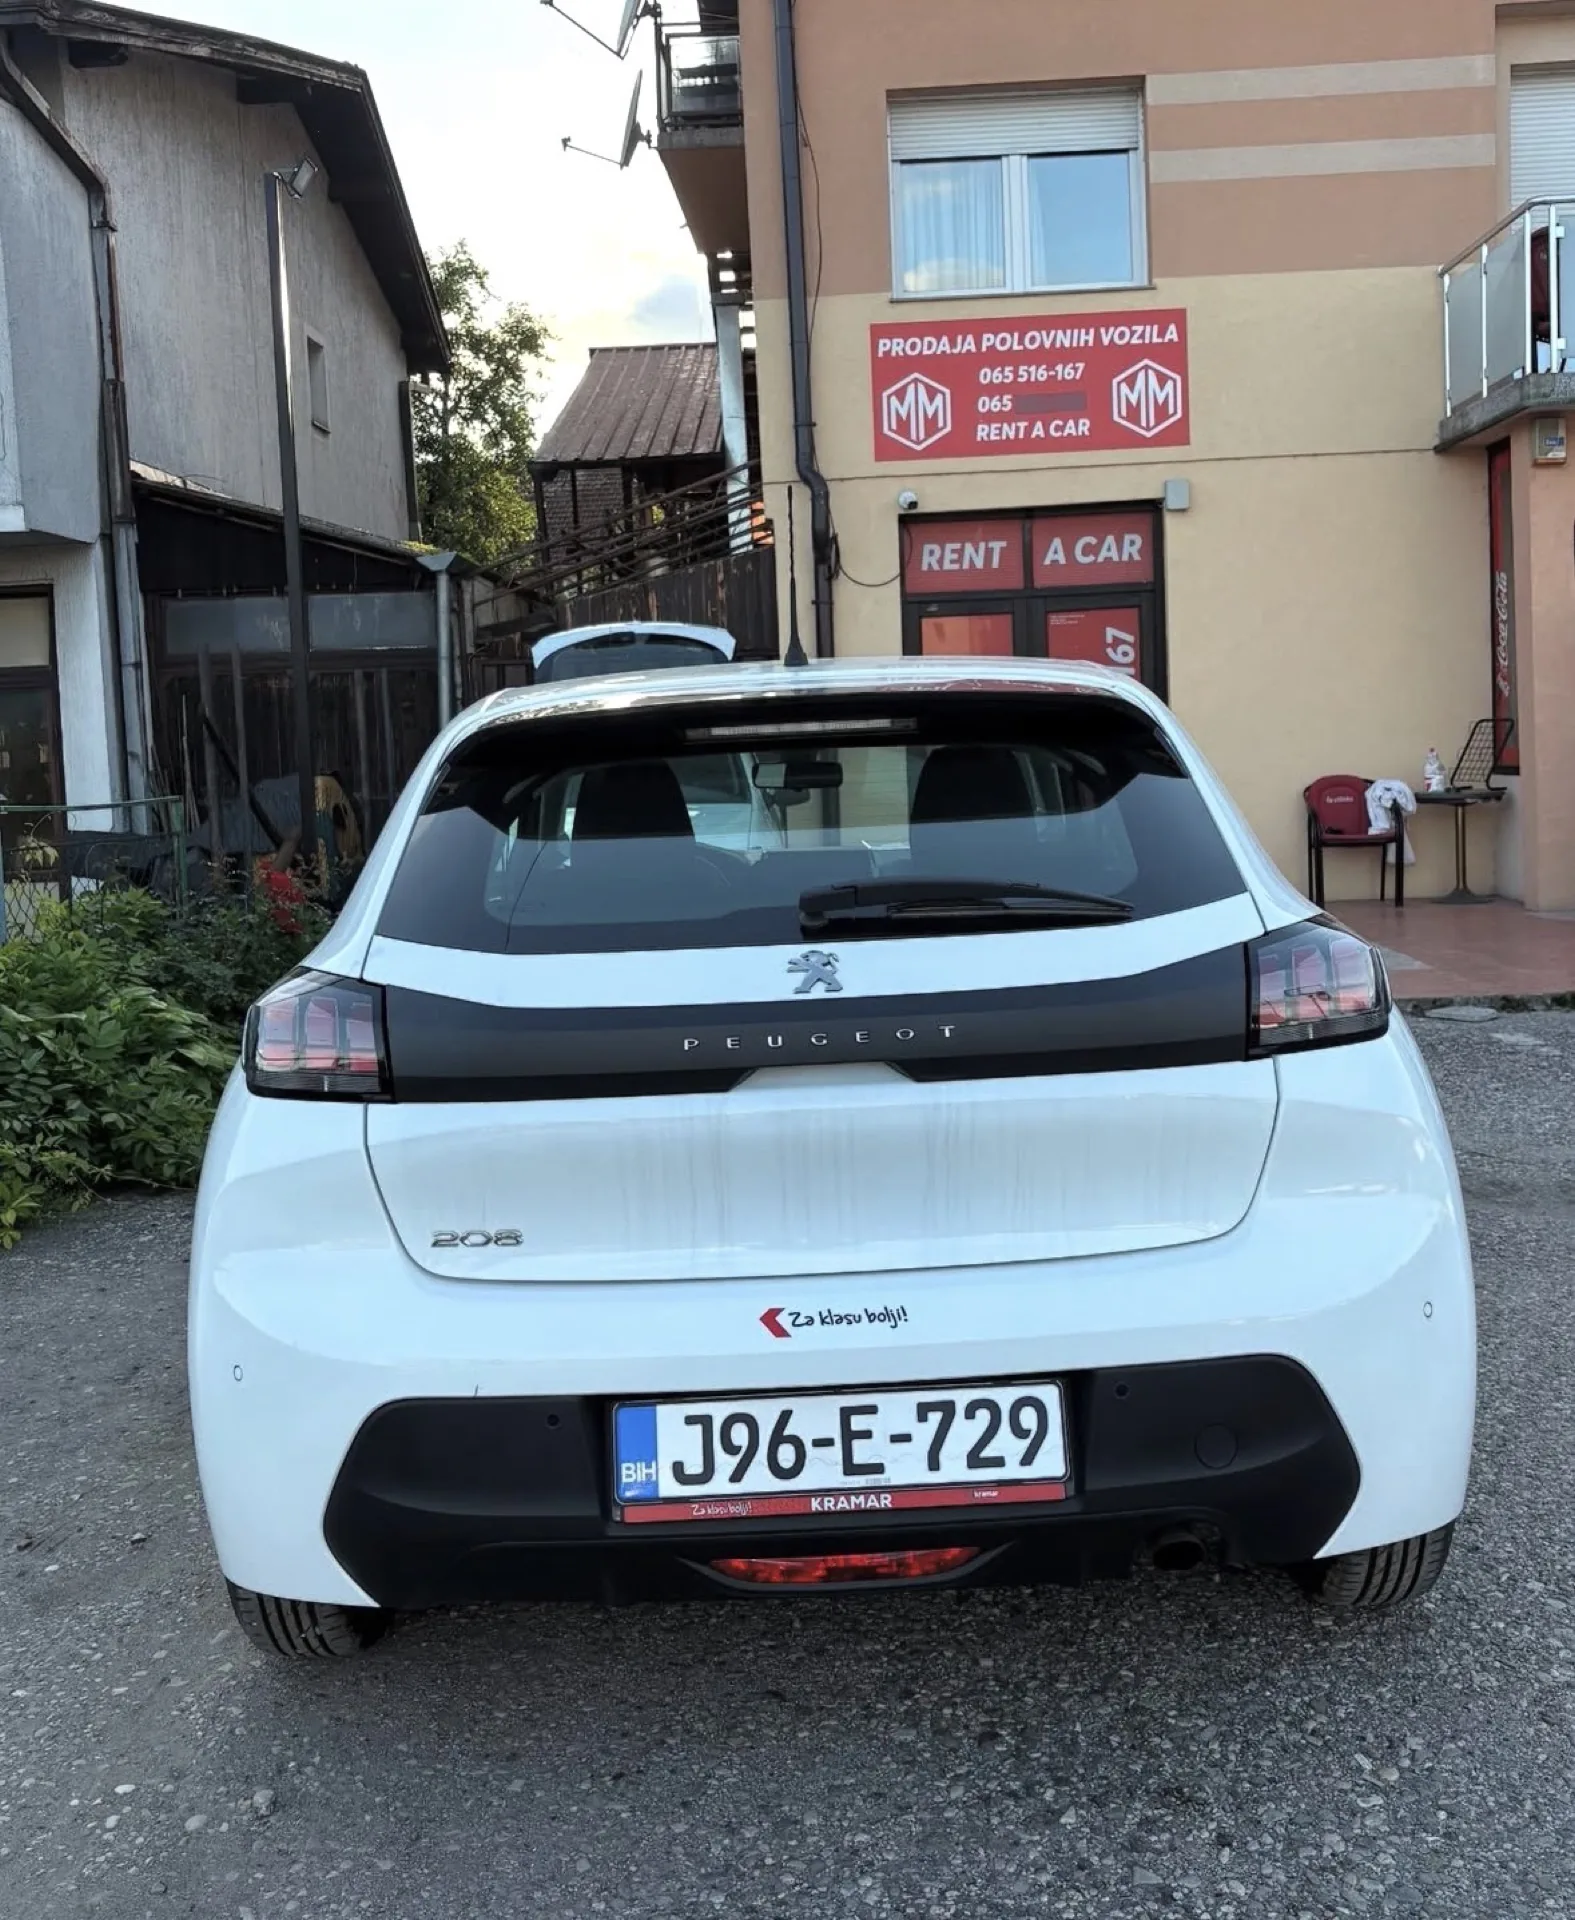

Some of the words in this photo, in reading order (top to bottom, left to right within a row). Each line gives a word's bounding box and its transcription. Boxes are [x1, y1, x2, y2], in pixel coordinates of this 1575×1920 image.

[877, 334, 977, 358] PRODAJA
[981, 328, 1095, 353] POLOVNIH
[1100, 323, 1179, 347] VOZILA
[979, 367, 1014, 385] 065
[1017, 362, 1086, 382] 516-167
[977, 395, 1013, 413] 065
[976, 421, 1027, 442] RENT
[1030, 421, 1046, 439] A
[1049, 418, 1091, 438] CAR
[921, 540, 1007, 571] RENT
[1043, 537, 1067, 565] A
[1074, 533, 1143, 564] CAR
[683, 1024, 957, 1051] PEUGEOT
[430, 1229, 524, 1248] 208
[788, 1311, 815, 1328] Za
[819, 1308, 862, 1326] klasu
[864, 1305, 908, 1329] bolji!
[671, 1395, 1049, 1486] J96-E-729
[620, 1461, 657, 1483] BIH
[810, 1493, 893, 1512] KRAMAR
